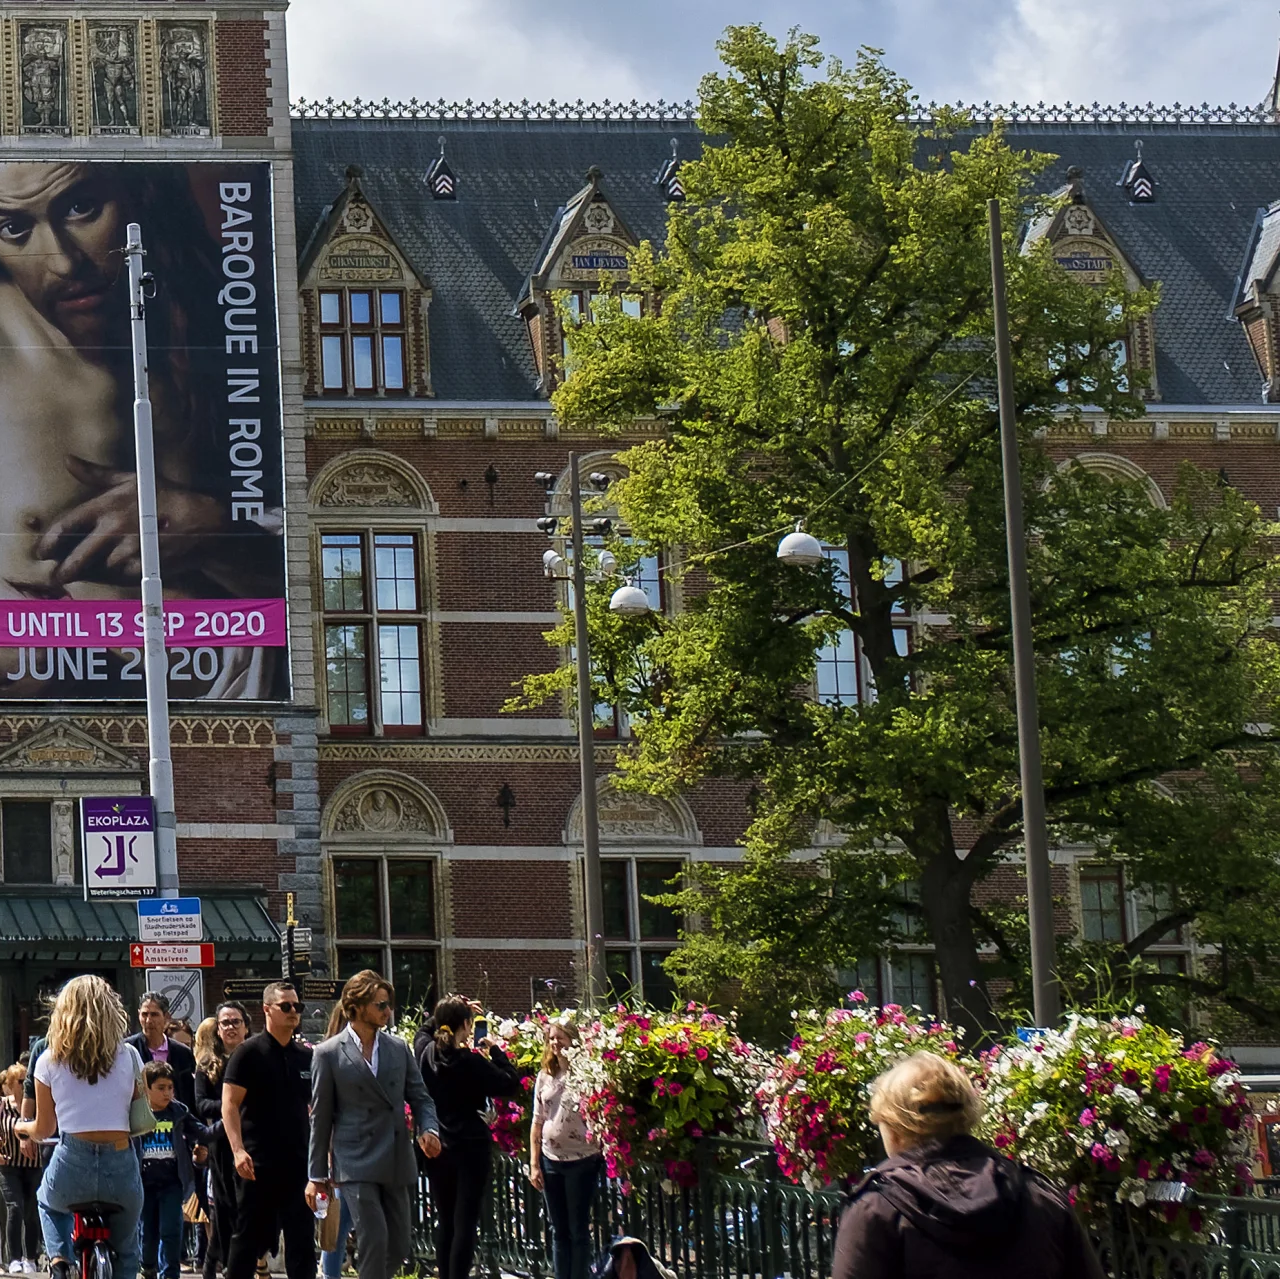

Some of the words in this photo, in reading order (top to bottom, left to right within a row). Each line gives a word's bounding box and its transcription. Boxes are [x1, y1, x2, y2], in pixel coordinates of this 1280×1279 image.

[217, 181, 258, 355] BAROQUE
[227, 367, 261, 404] IN
[228, 418, 265, 521] ROME
[8, 610, 89, 638] UNTIL
[95, 610, 124, 638] 13
[133, 611, 185, 637] SP
[194, 610, 266, 638] 2020
[6, 647, 108, 681] JUNE
[120, 647, 219, 681] 220
[88, 816, 150, 827] EKOPLAZA
[90, 888, 142, 896] Weteringschans
[162, 929, 189, 937] fietspad
